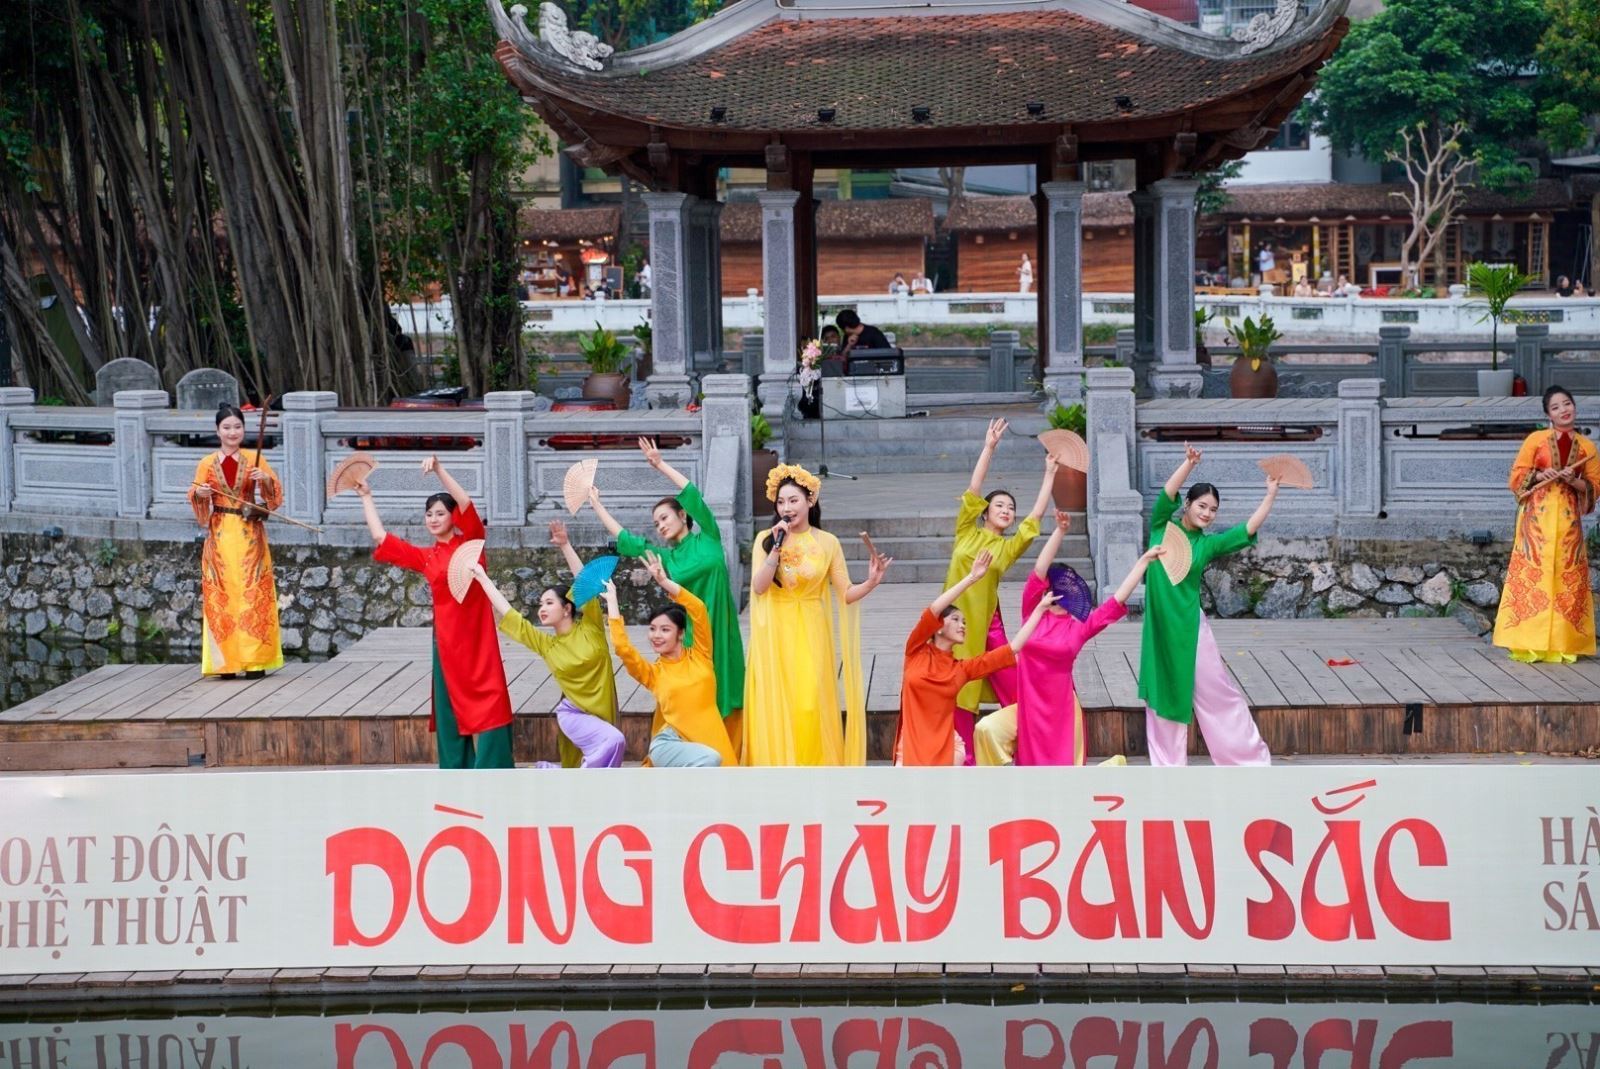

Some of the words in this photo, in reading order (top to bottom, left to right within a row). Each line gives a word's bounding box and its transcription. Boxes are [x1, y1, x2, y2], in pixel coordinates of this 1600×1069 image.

[110, 822, 248, 894] ĐỘNG
[325, 804, 655, 950] DÒNG
[683, 800, 963, 946] CHẢY
[989, 796, 1217, 942] BẢN
[1244, 780, 1453, 944] SẮC
[1539, 805, 1600, 866] HÀ
[0, 888, 69, 960] HỆ
[84, 885, 248, 957] THUẬT
[1543, 870, 1600, 932] SÁ
